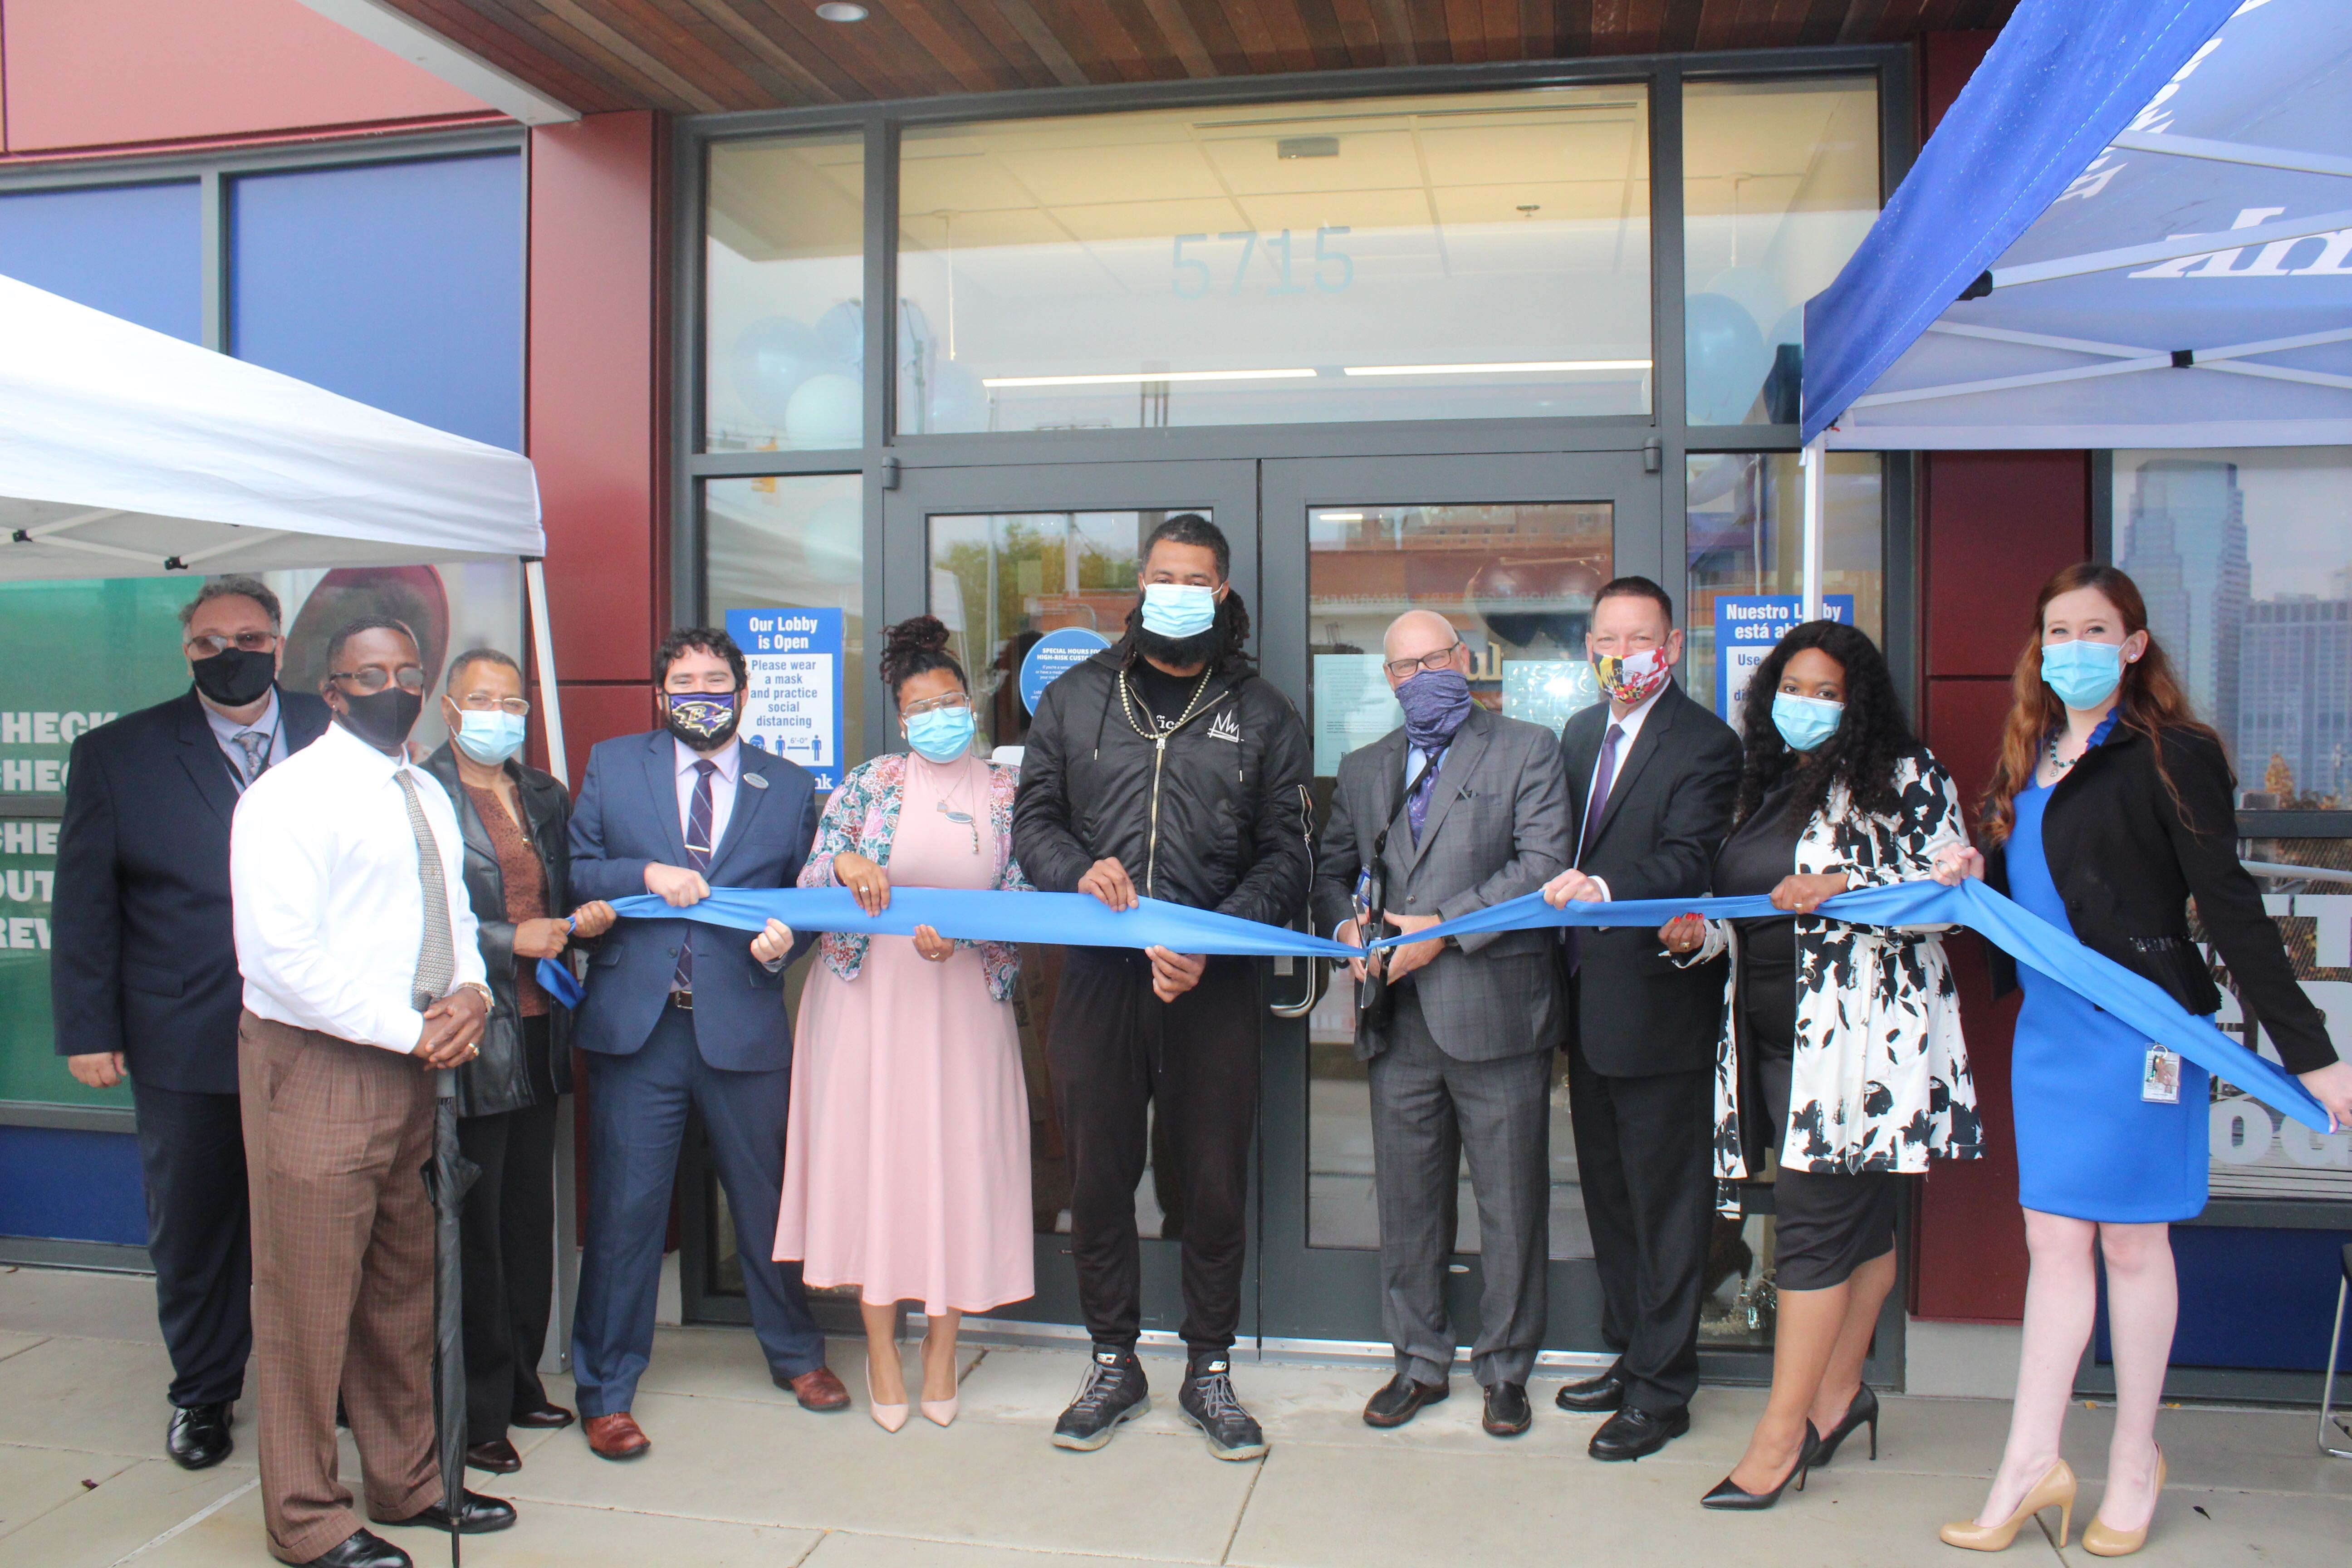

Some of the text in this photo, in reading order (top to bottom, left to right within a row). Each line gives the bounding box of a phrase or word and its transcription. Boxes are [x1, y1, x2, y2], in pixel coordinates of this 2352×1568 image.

[1171, 225, 1353, 300] 5715
[1726, 603, 1842, 622] Nuestro Lby
[750, 616, 818, 634] Our Lobby
[1735, 622, 1769, 639] está
[758, 634, 808, 652] is Open
[752, 660, 816, 670] Please wear
[1738, 654, 1760, 665] Use
[765, 673, 803, 684] a mask
[750, 687, 817, 700] and practice
[768, 701, 799, 712] social
[757, 716, 812, 728] distancing
